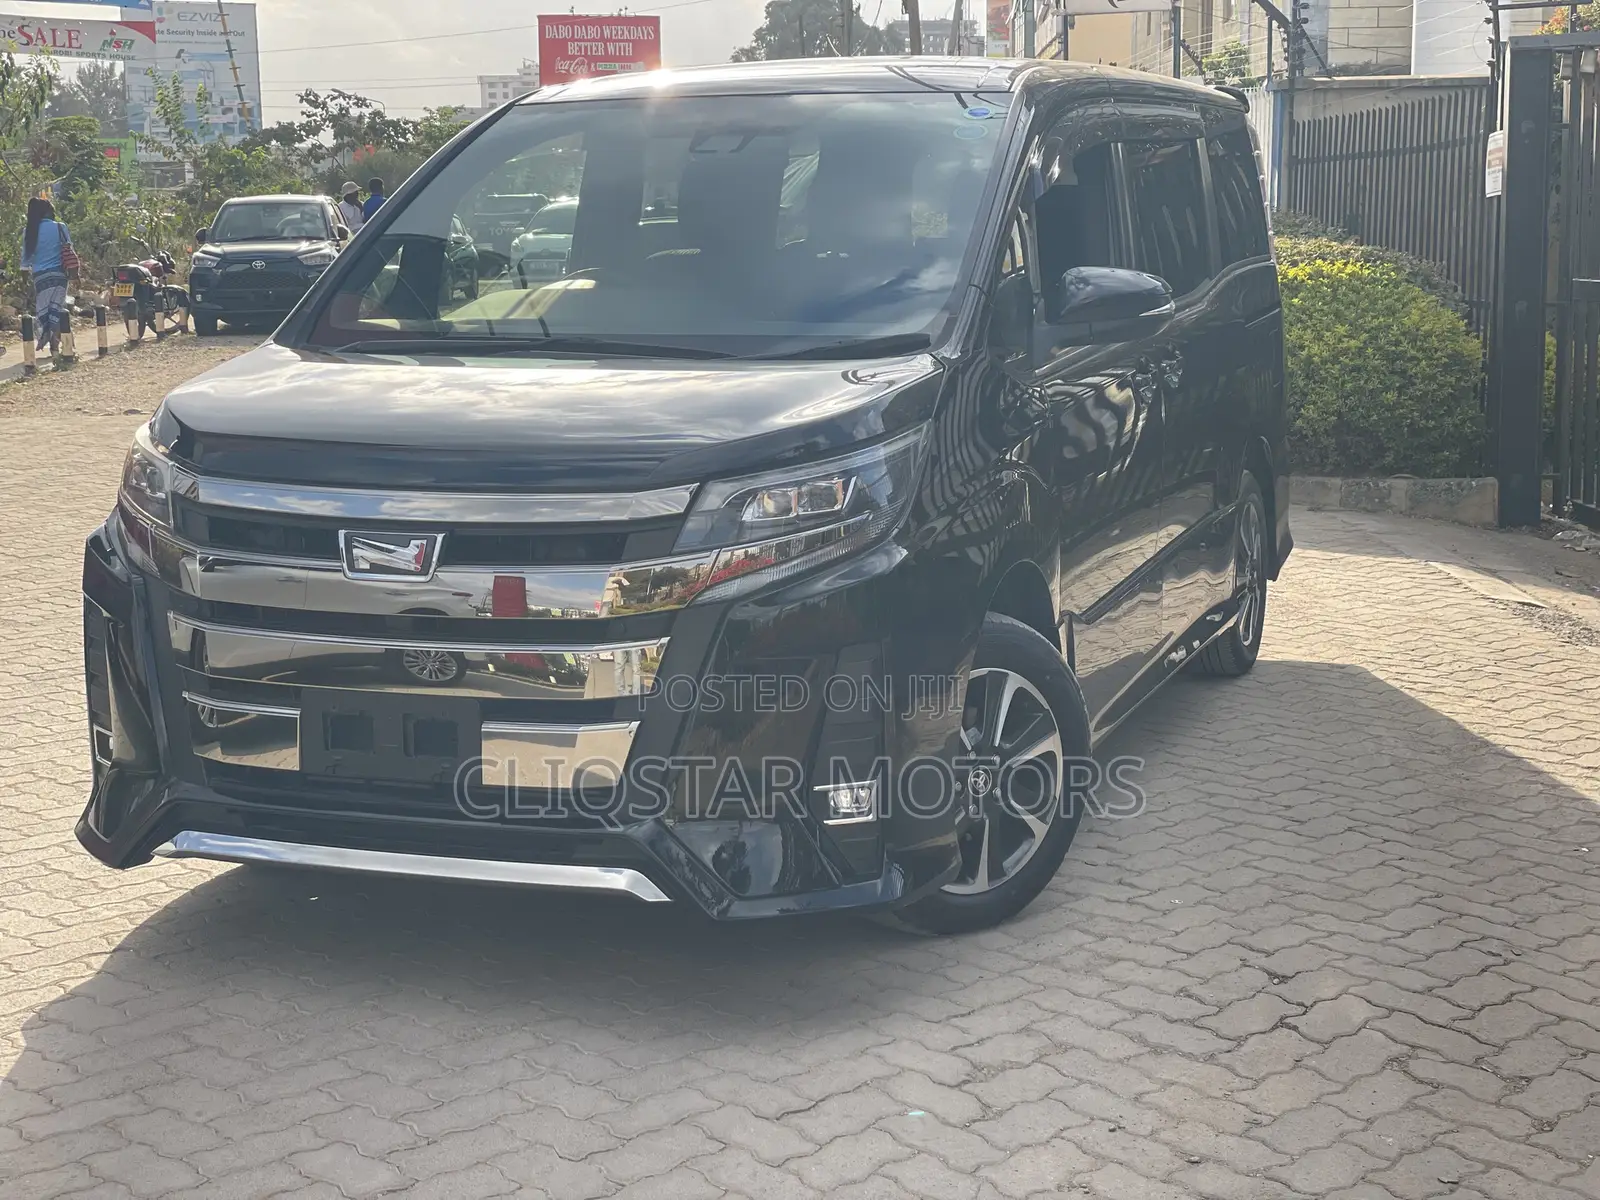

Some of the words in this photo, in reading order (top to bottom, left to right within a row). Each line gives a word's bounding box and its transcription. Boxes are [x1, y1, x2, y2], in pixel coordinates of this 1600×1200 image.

[177, 12, 222, 22] EZVIZ
[16, 22, 83, 50] SALE
[166, 29, 194, 37] Security
[546, 25, 572, 39] DABO
[574, 26, 600, 39] DABO
[603, 26, 654, 40] WEEKDAYS
[76, 51, 106, 59] SPORTS
[568, 42, 604, 56] BETTER
[607, 42, 633, 56] WITH
